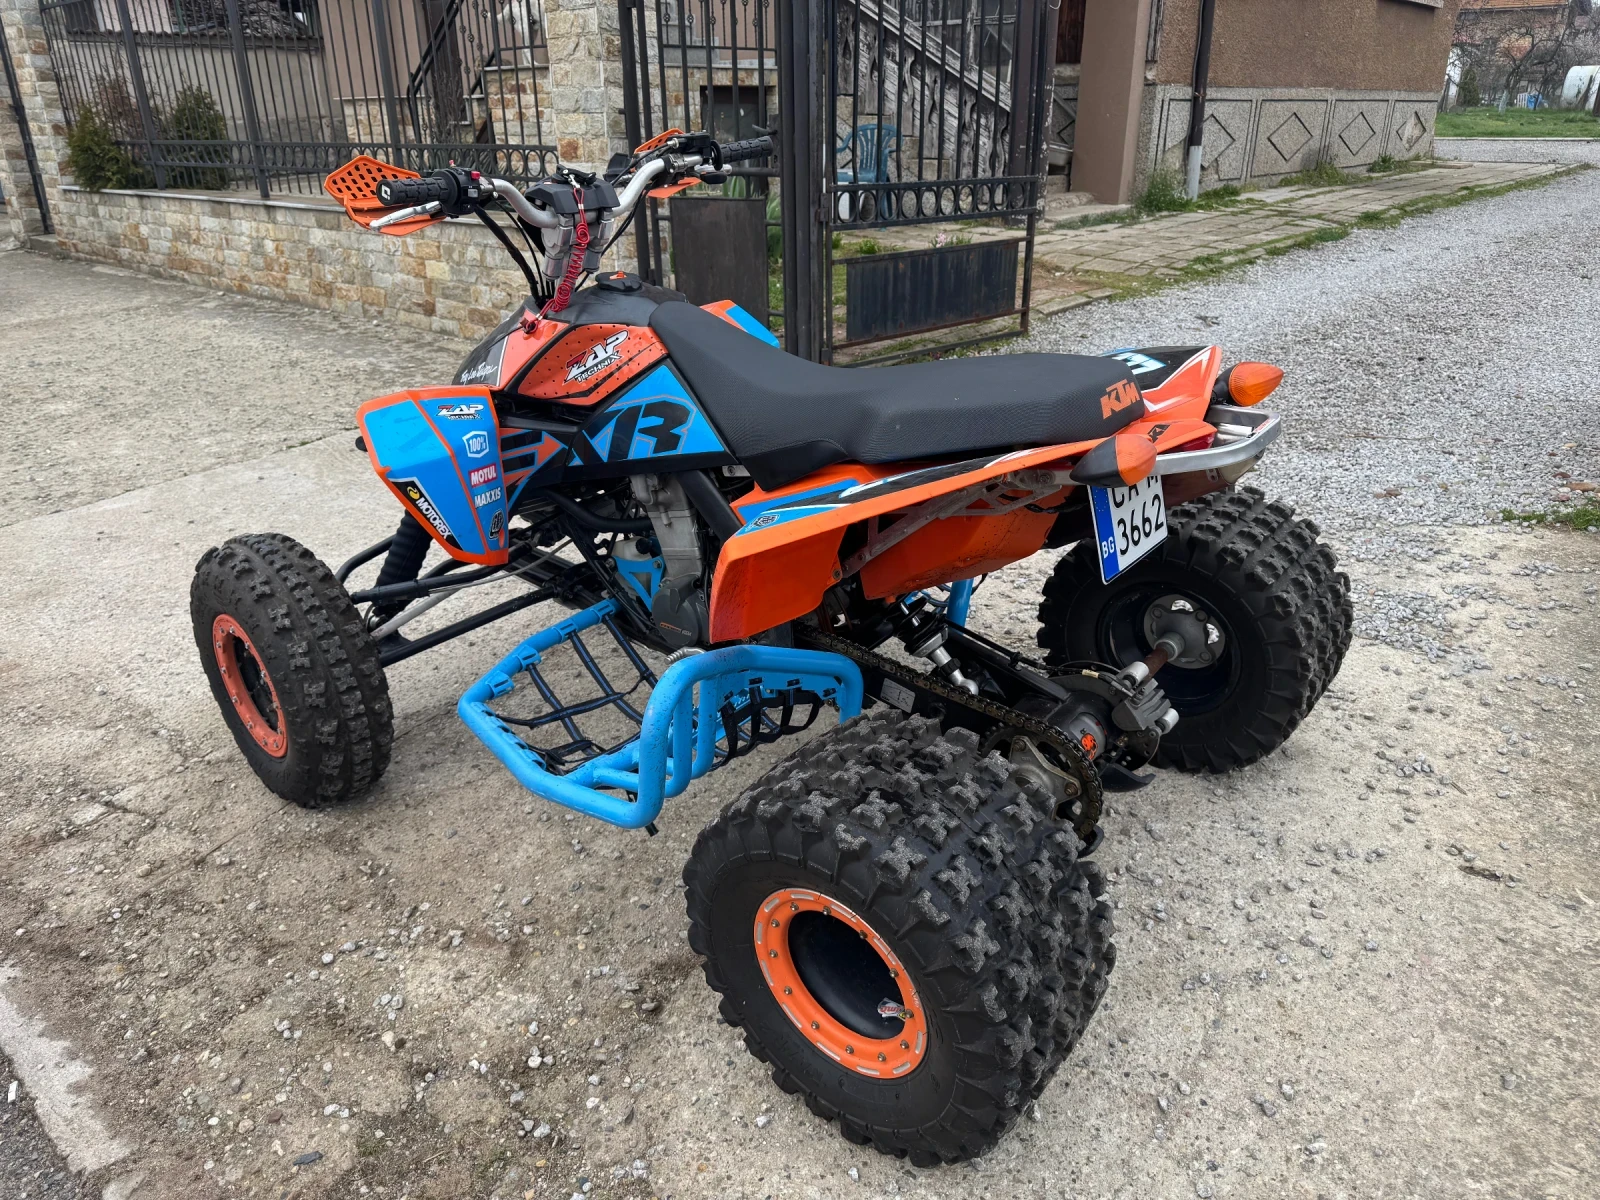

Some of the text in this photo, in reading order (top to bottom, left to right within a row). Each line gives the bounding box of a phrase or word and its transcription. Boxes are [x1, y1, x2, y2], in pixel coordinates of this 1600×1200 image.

[564, 330, 628, 383] ZAP
[575, 349, 624, 383] TECHNIX
[437, 404, 484, 417] ZAP
[1100, 378, 1140, 420] KTM
[469, 436, 486, 453] 100%
[470, 464, 497, 486] MOTUL
[474, 487, 502, 509] MAXXIS
[415, 497, 452, 540] MOTOREX
[1117, 493, 1165, 556] 3662
[1101, 536, 1117, 559] BG
